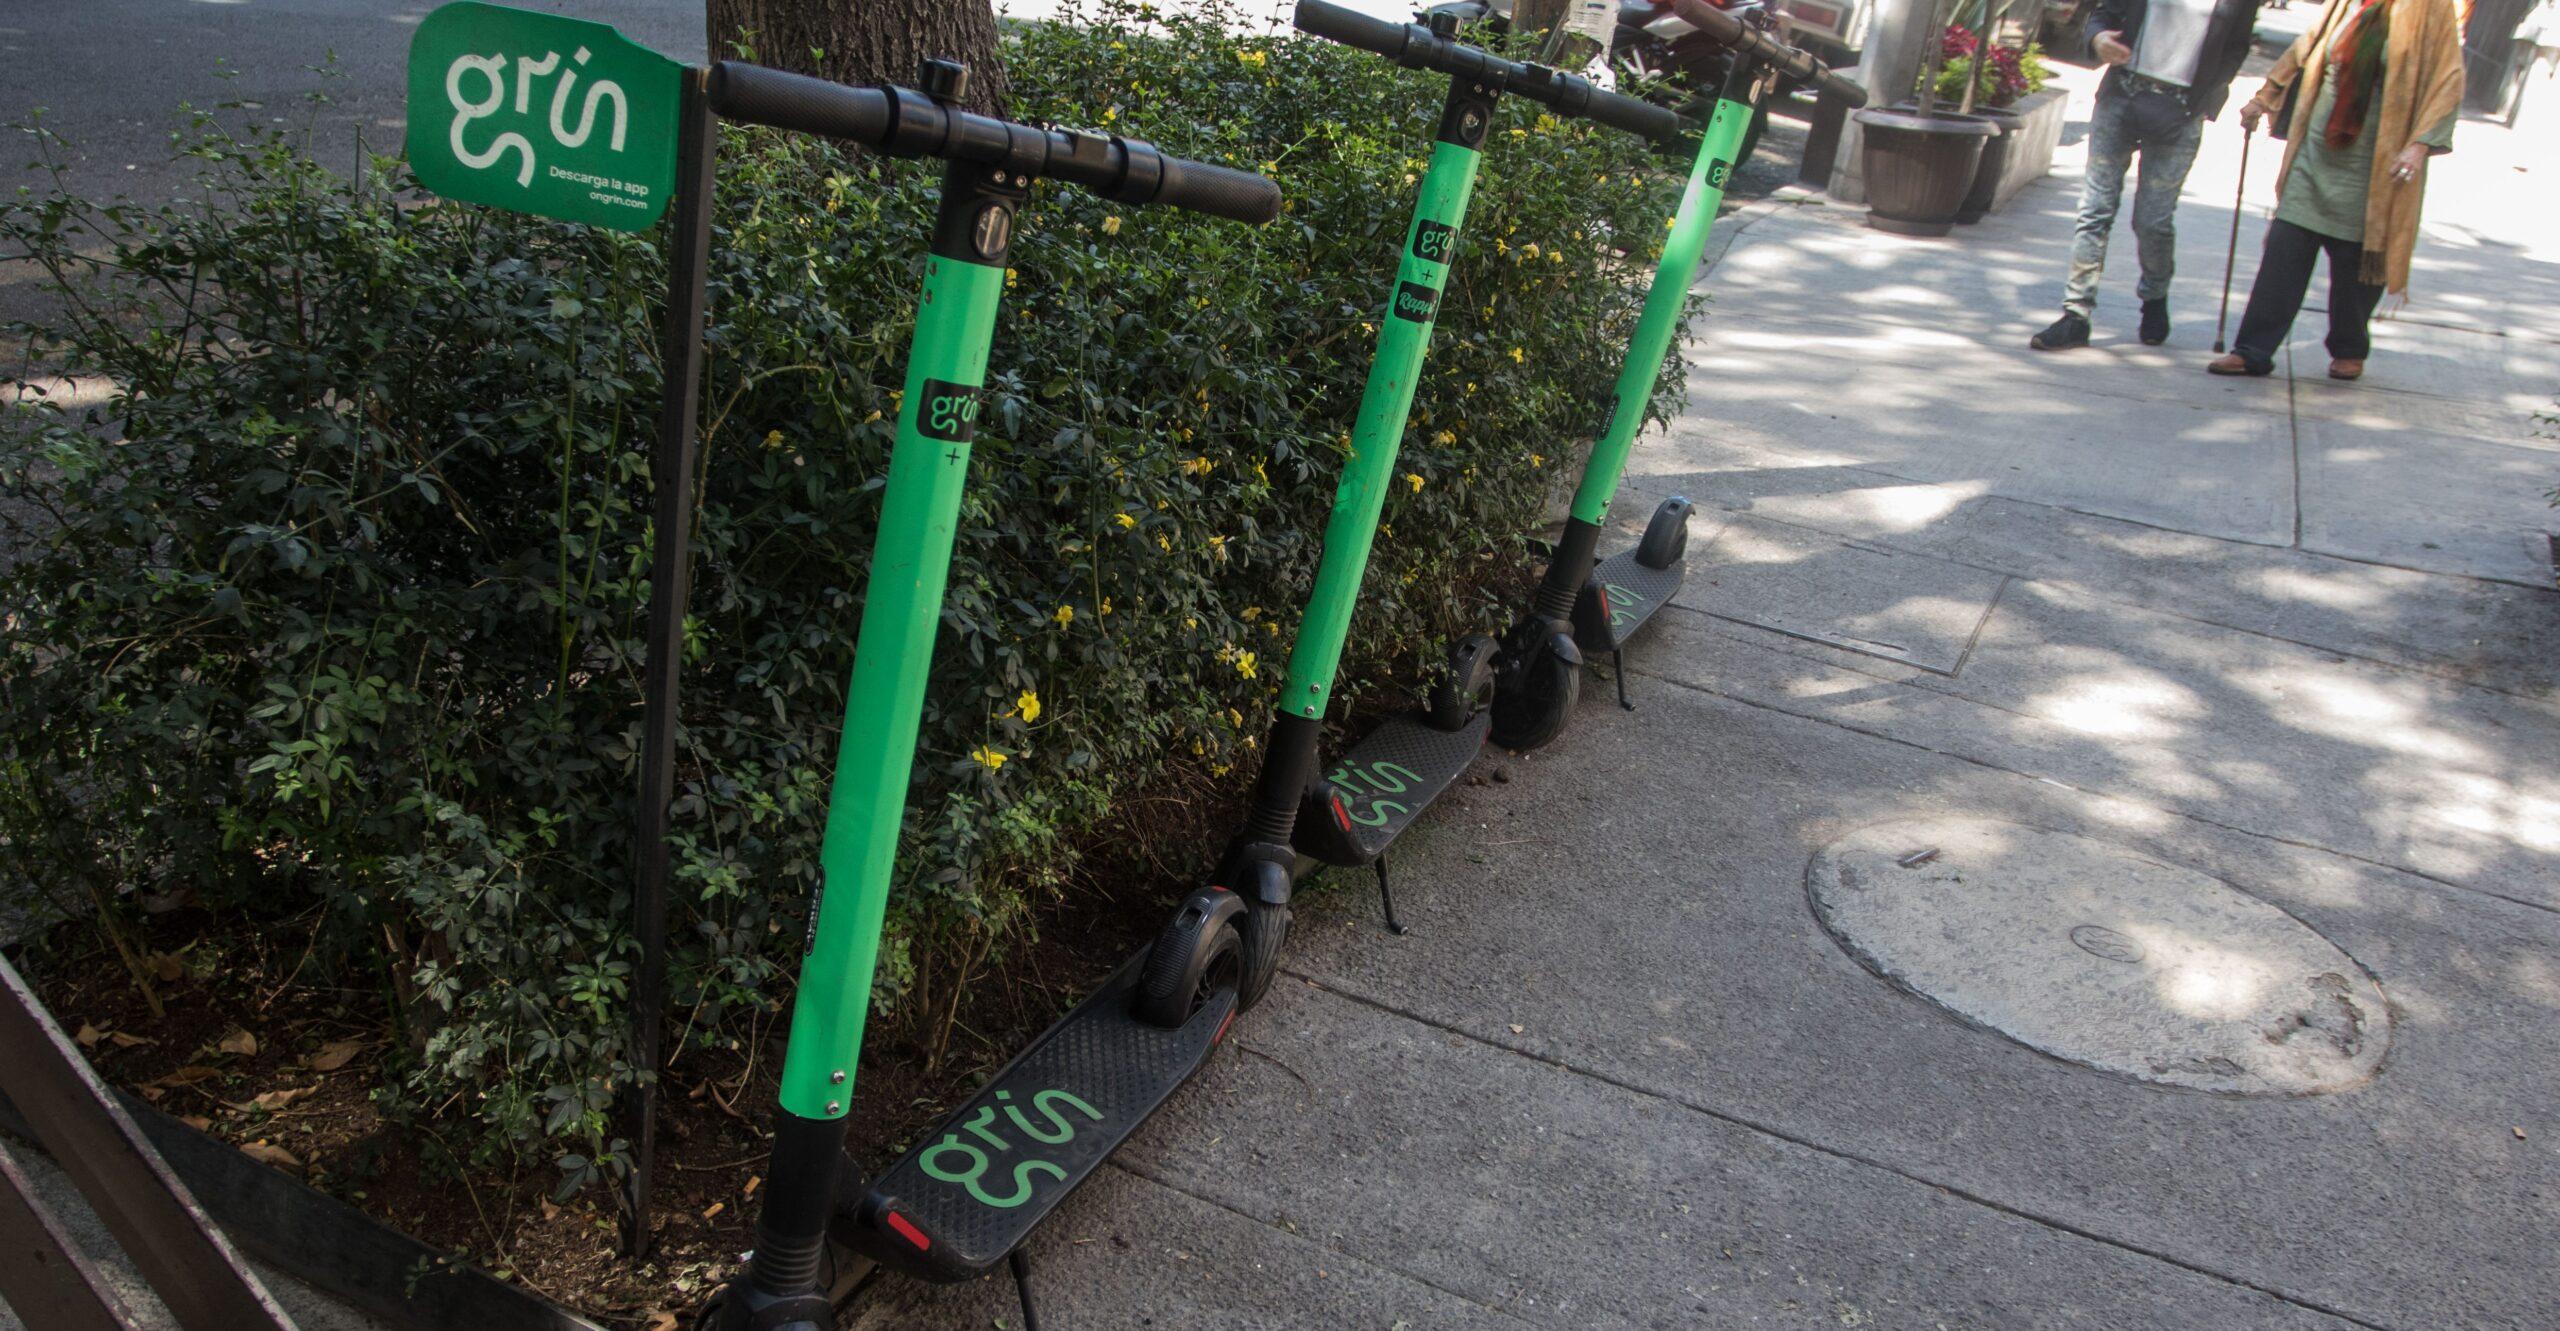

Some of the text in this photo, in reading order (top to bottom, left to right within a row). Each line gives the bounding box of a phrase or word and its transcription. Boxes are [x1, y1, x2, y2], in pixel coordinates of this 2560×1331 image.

[446, 45, 628, 189] grin
[549, 165, 649, 197] Descarga la app
[589, 191, 648, 210] ongrin.com
[930, 392, 978, 435] grin
[918, 1089, 1105, 1208] grin
